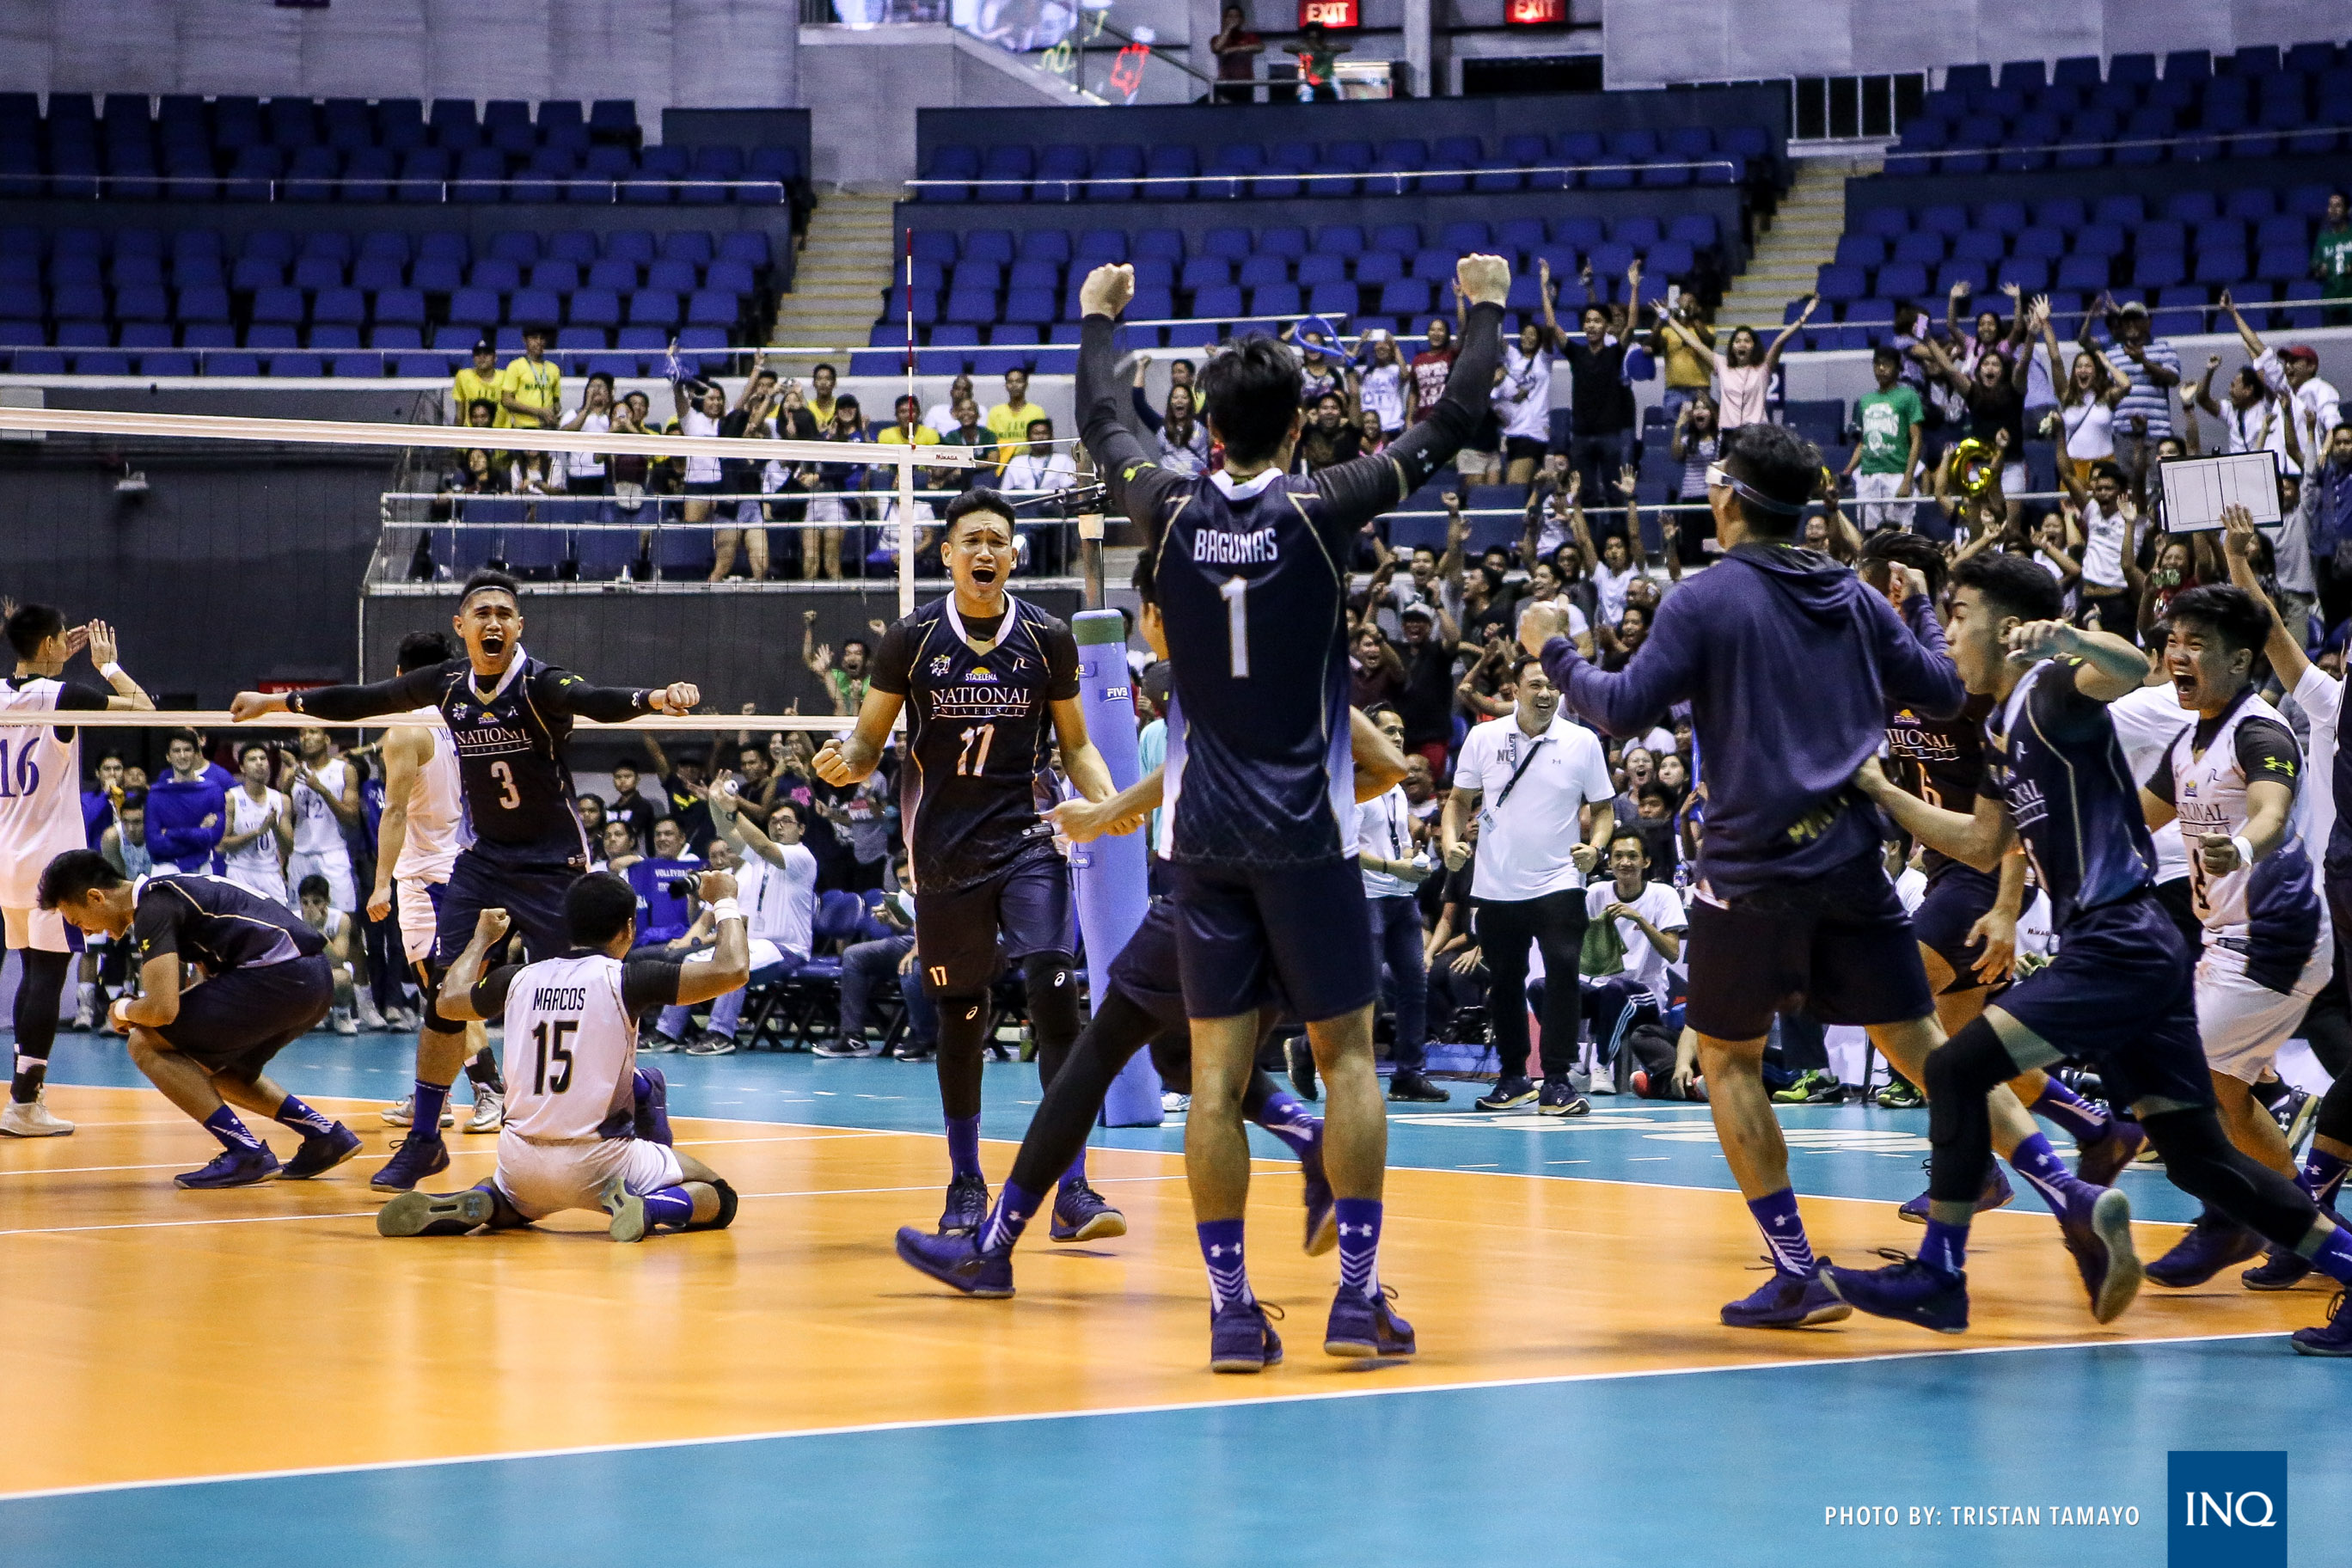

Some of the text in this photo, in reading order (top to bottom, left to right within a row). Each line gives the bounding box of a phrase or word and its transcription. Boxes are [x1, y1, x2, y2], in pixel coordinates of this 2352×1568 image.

[1306, 2, 1349, 23] EXIT
[1514, 0, 1554, 20] EXIT
[1193, 527, 1279, 564] BAGUNAS
[1219, 574, 1251, 679] 1
[929, 687, 1032, 706] NATIONAL
[957, 723, 995, 777] 17
[0, 737, 40, 798] 16
[490, 760, 521, 810] 3
[2027, 927, 2053, 937] MIKAS
[928, 965, 948, 987] 17
[532, 987, 586, 1011] MARCOS
[530, 1020, 579, 1097] 15
